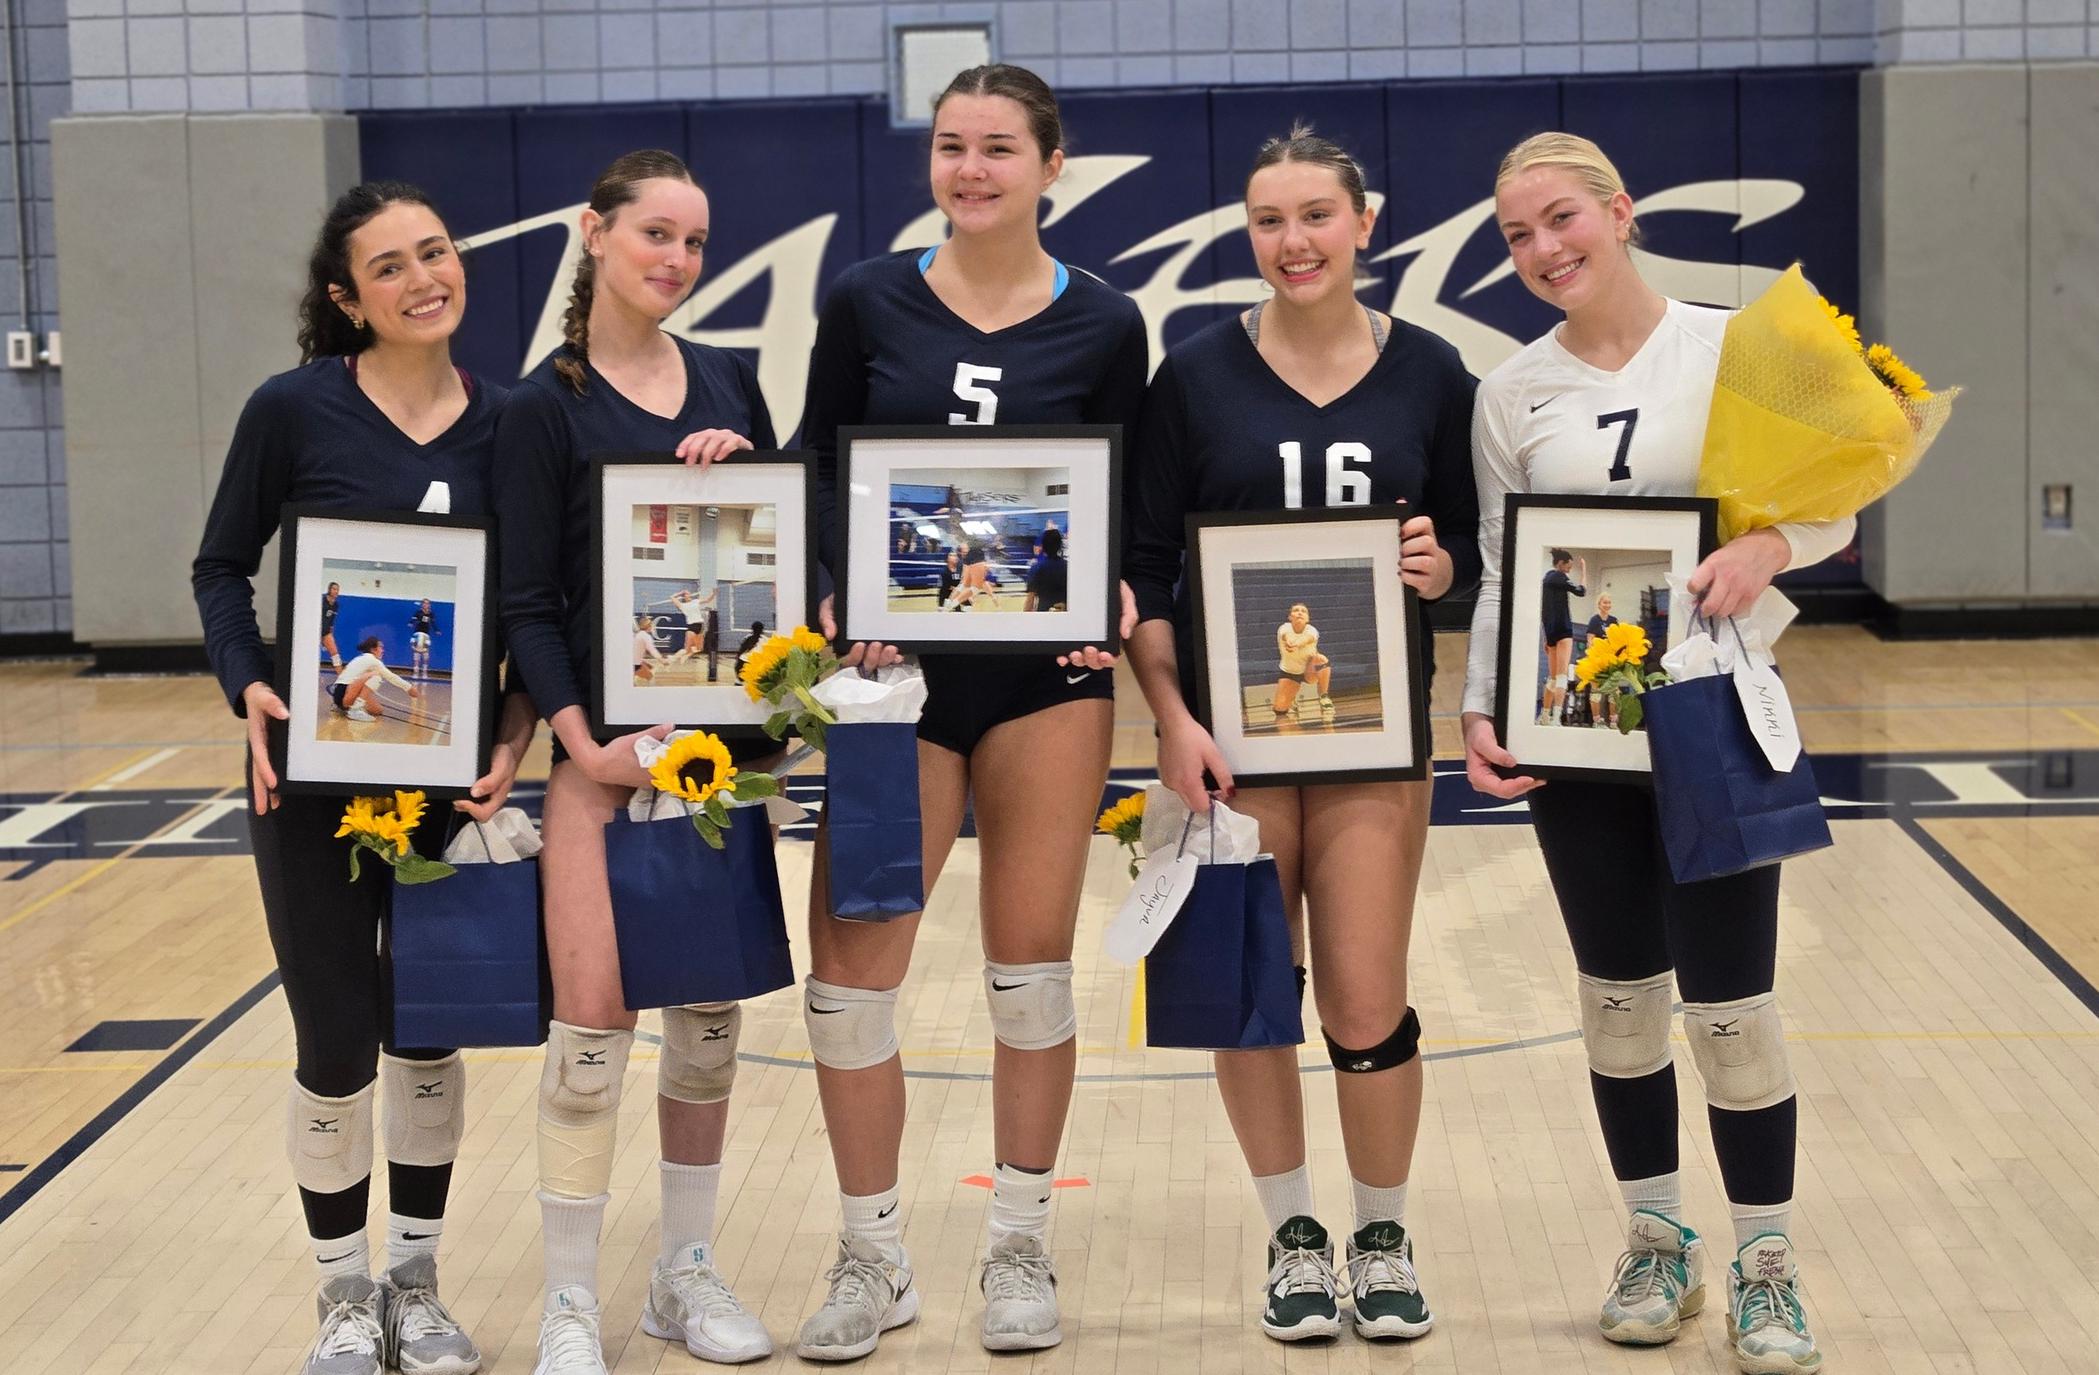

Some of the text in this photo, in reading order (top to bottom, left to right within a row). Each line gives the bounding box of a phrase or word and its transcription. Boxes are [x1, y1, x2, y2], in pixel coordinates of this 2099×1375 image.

[948, 362, 1003, 425] 5
[1278, 441, 1372, 509] 16
[1597, 407, 1641, 482] 7
